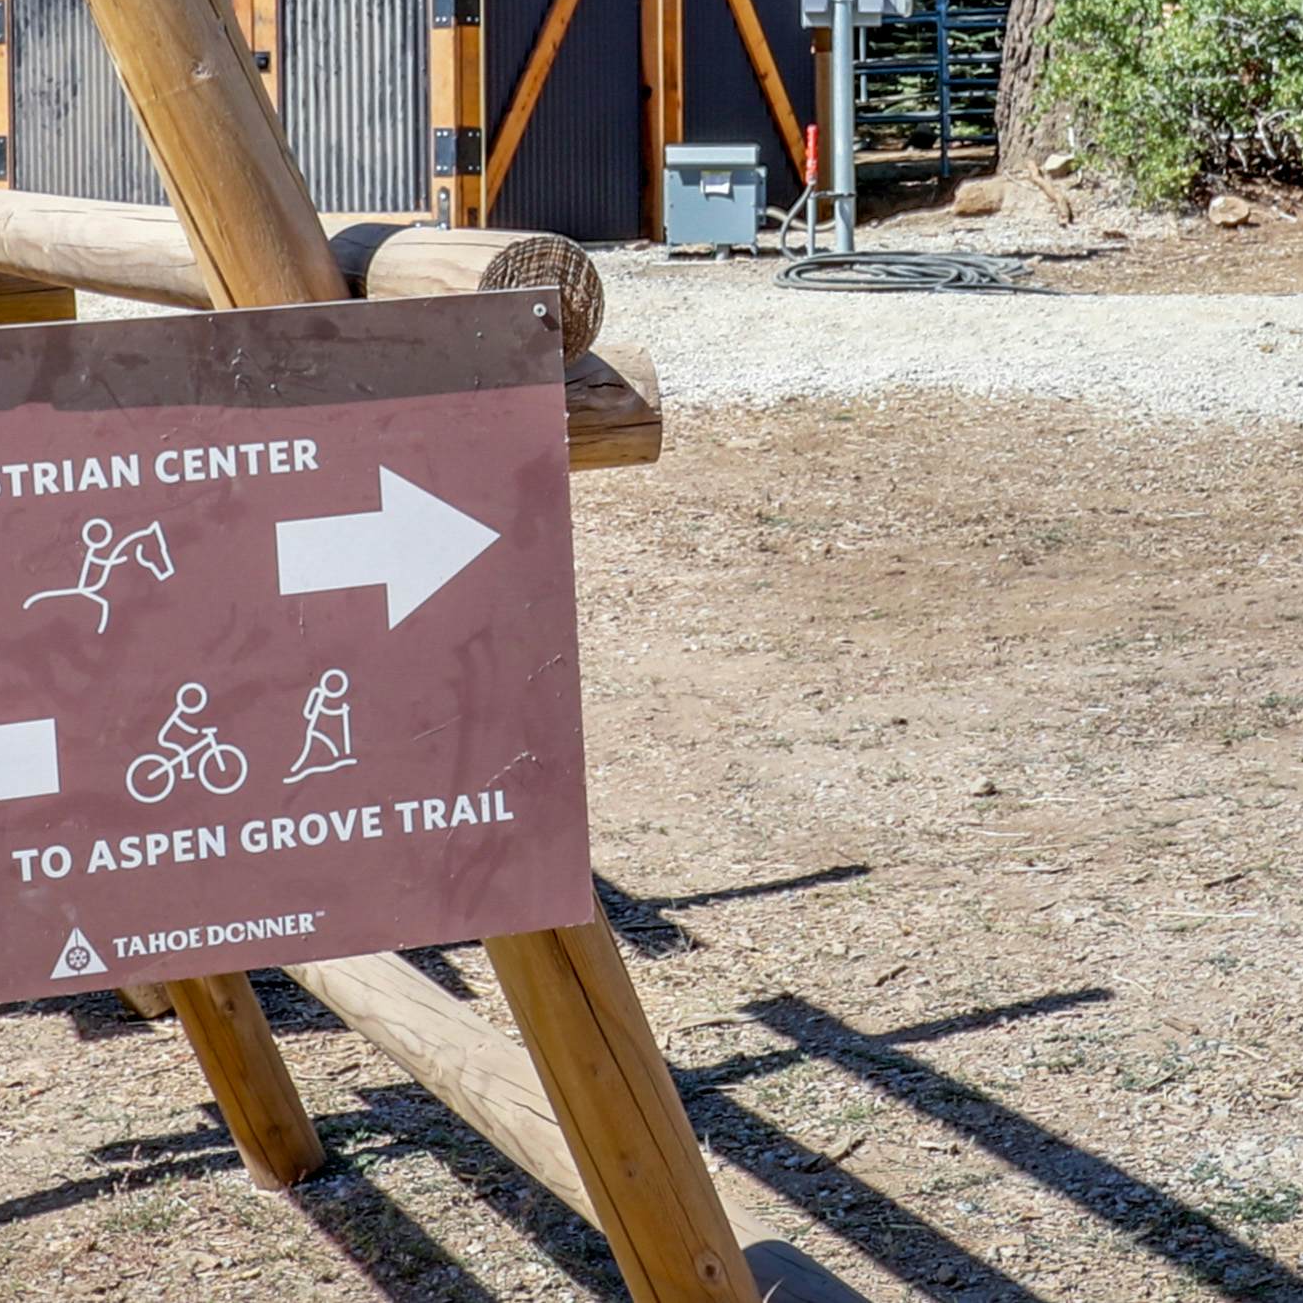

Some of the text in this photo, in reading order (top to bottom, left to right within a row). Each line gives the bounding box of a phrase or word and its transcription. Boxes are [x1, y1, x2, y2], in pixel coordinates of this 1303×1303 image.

[154, 439, 319, 483] CENTER
[12, 790, 514, 882] TO ASPEN GROVE TRAIL
[113, 913, 315, 958] TAHOE DONNER
